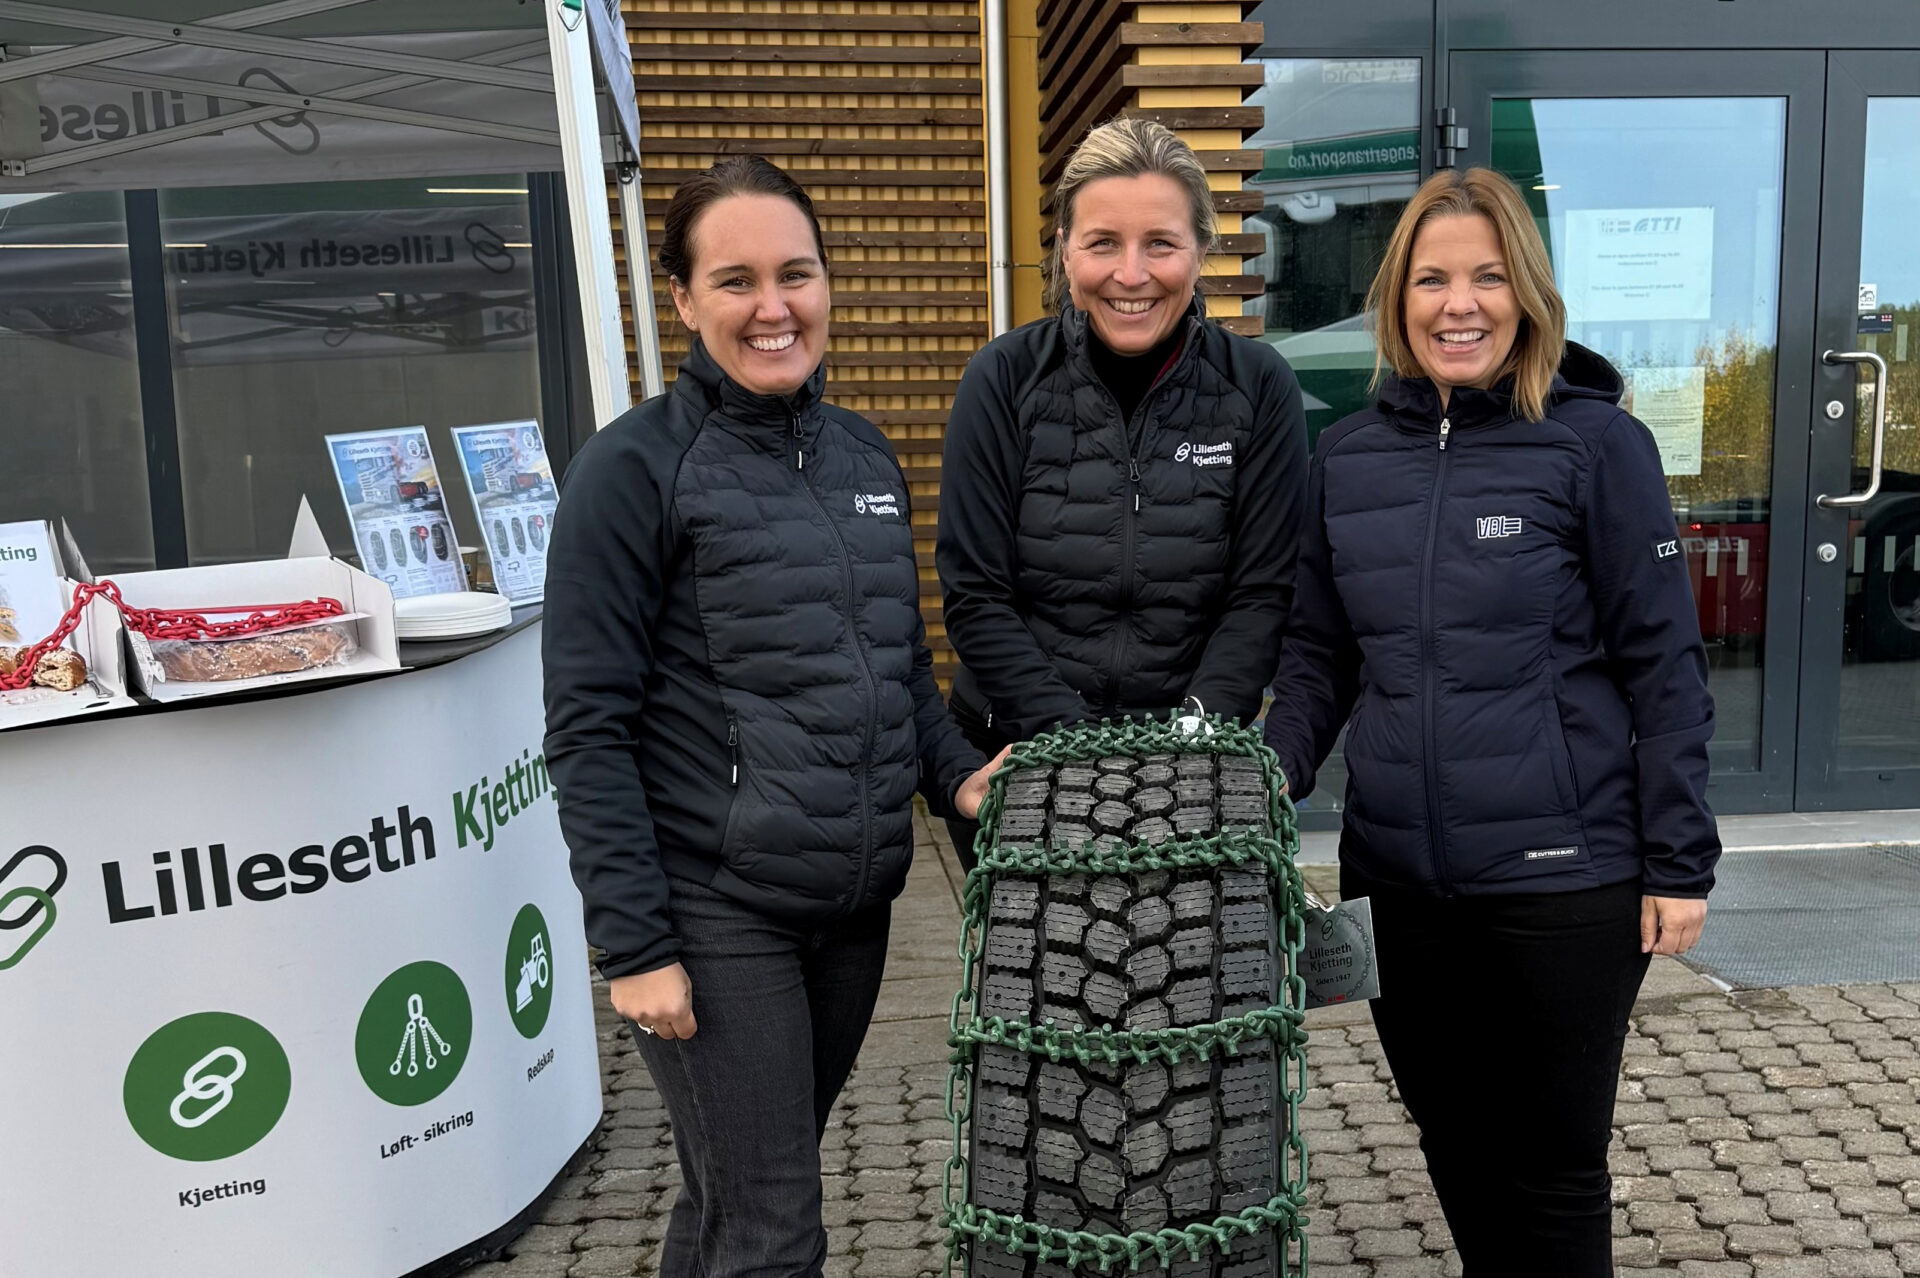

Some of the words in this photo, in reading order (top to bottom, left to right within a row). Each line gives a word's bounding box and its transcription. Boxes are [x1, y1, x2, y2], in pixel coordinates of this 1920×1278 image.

[1193, 441, 1232, 454] Lilleseth
[1193, 454, 1232, 467] Kjetting
[0, 546, 38, 562] ting
[101, 804, 437, 924] Lilleseth
[452, 748, 558, 853] Kjettin
[1309, 942, 1352, 960] Lilleseth
[1310, 957, 1353, 972] Kjetting
[527, 1048, 555, 1083] Redskap
[423, 1110, 474, 1142] sikring
[178, 1177, 267, 1208] Kjetting
